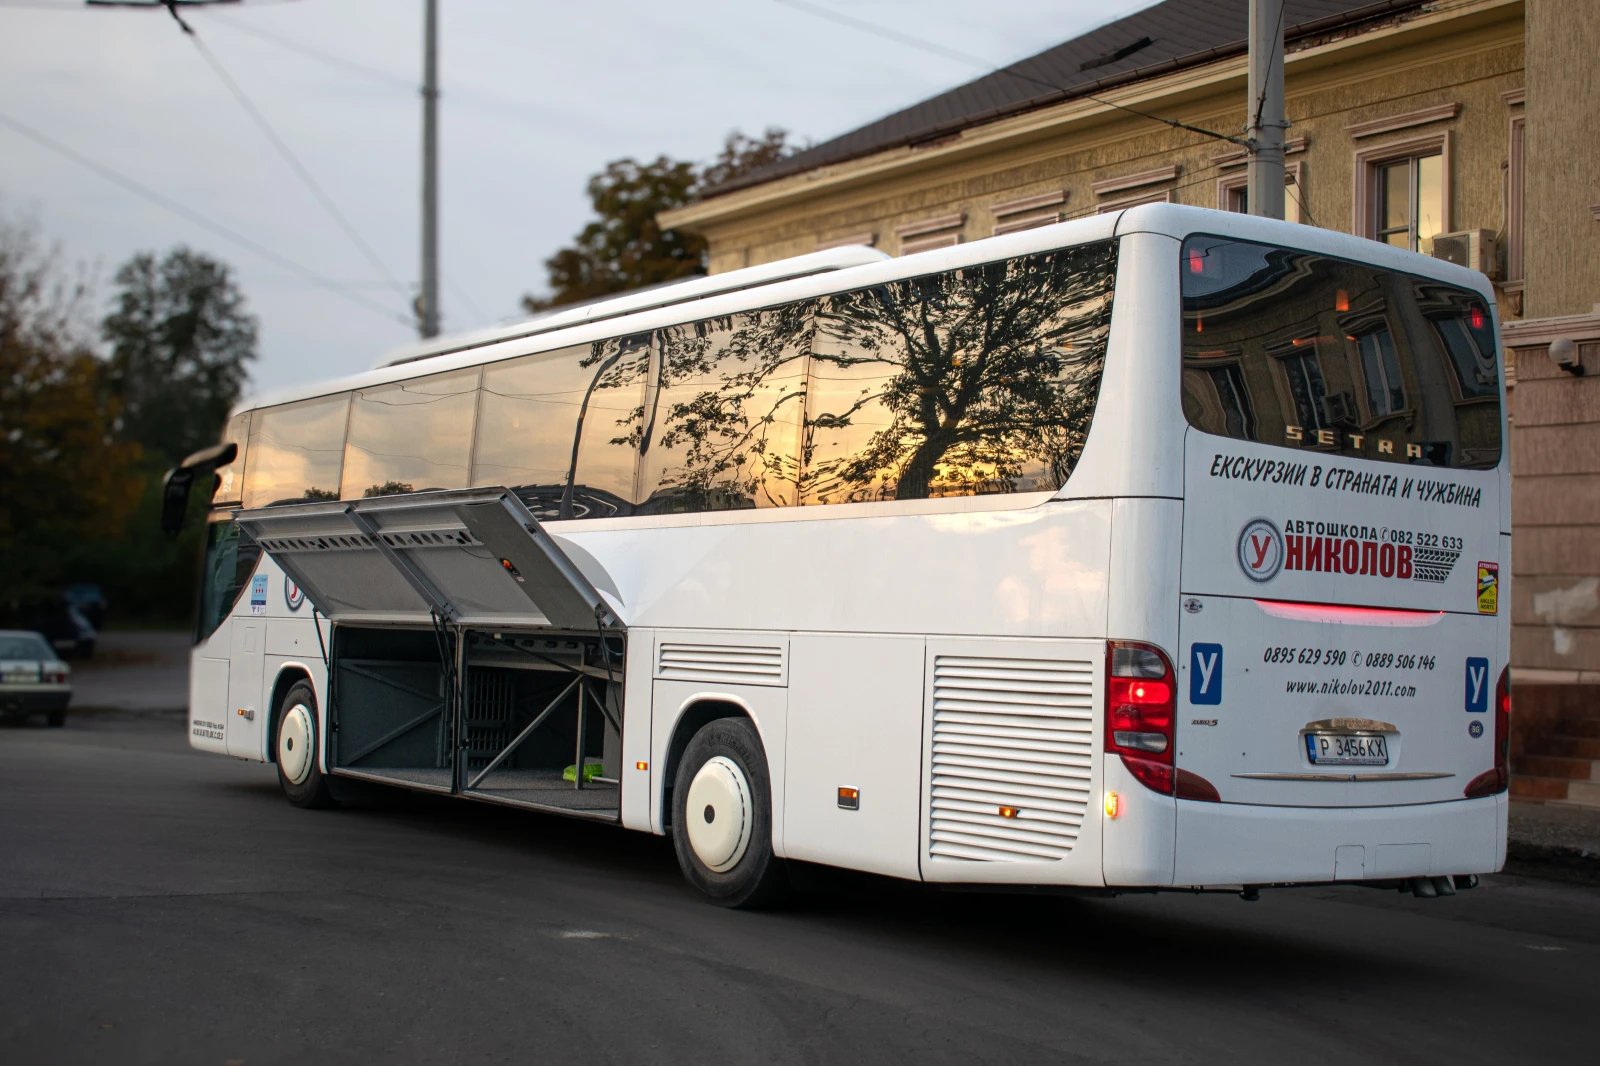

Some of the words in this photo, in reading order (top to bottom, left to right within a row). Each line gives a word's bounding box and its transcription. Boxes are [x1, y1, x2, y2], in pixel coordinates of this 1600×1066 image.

[1286, 425, 1422, 458] SETRA
[1210, 454, 1308, 486] ЕКСКУРЗИИ
[1310, 465, 1322, 487] В
[1325, 467, 1398, 498] СТРАНАТА
[1401, 477, 1414, 499] И
[1416, 479, 1481, 508] ЧУЖБИНА
[1284, 519, 1378, 541] АВТОШКОЛА
[1390, 529, 1413, 545] 082
[1416, 532, 1438, 547] 522
[1442, 535, 1463, 550] 633
[1284, 534, 1413, 579] НИКОЛОВ
[1263, 646, 1297, 664] 0895
[1298, 647, 1322, 665] 629
[1323, 649, 1346, 666] 590
[1365, 652, 1394, 669] 0889
[1394, 654, 1416, 670] 506
[1417, 654, 1436, 671] 146
[1286, 678, 1417, 697] www.nikolov2011.com
